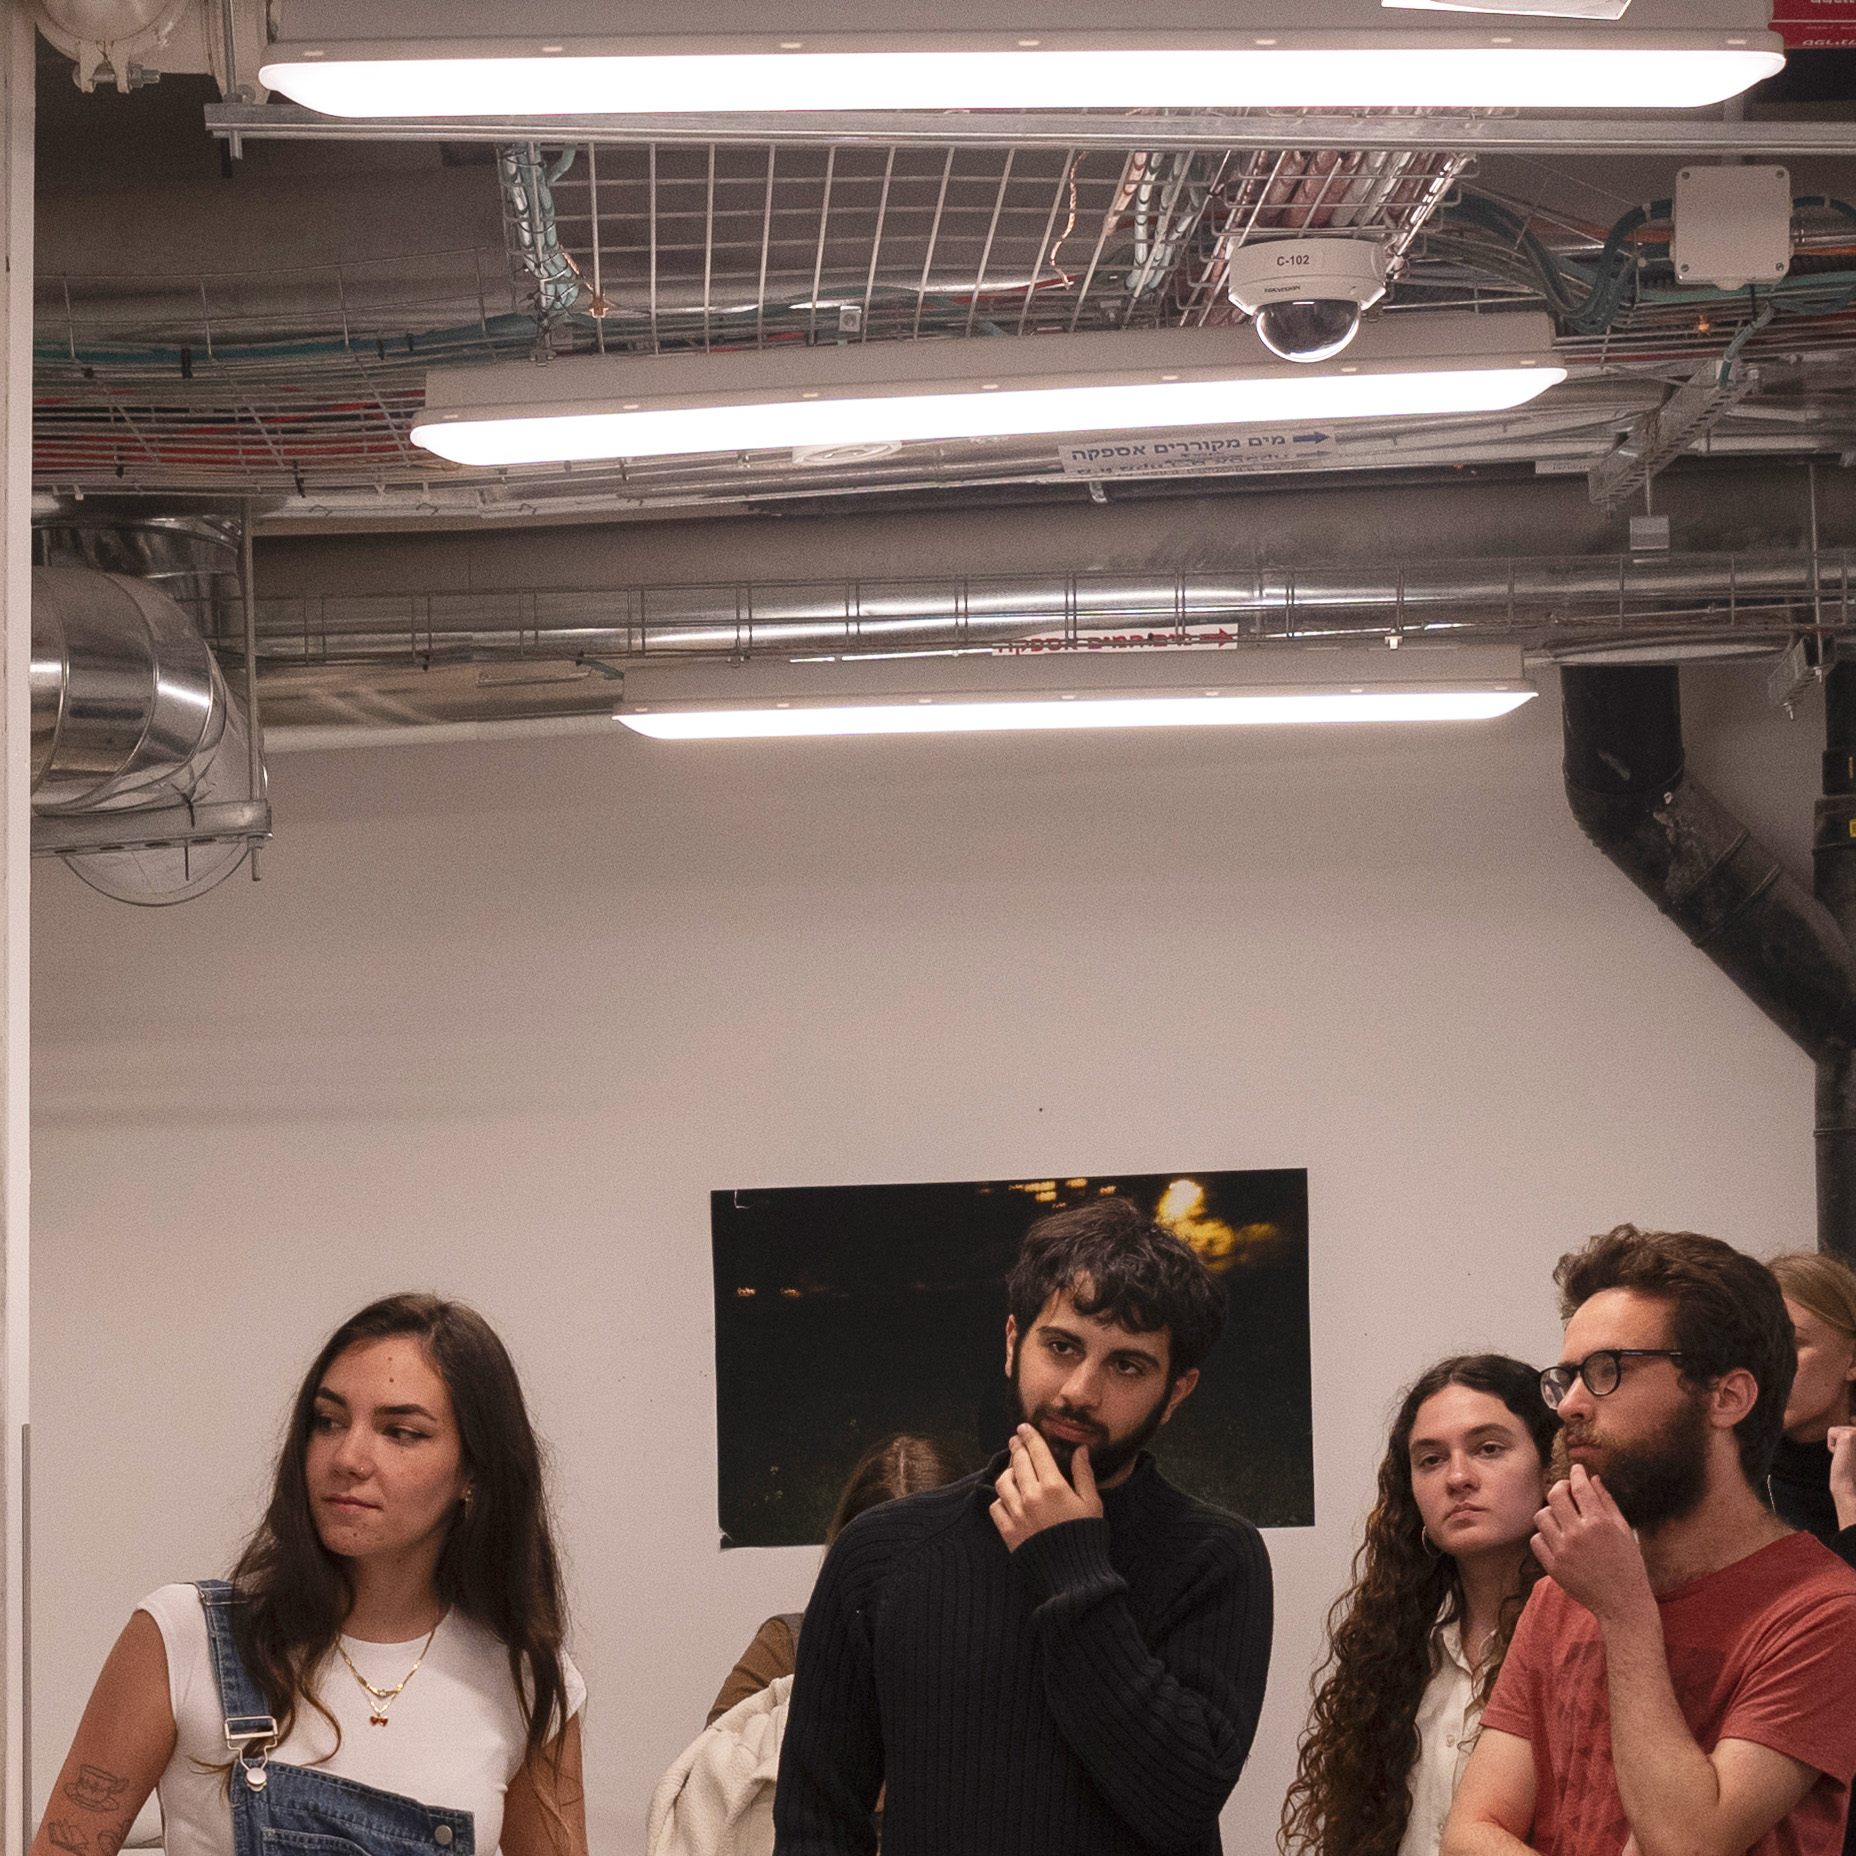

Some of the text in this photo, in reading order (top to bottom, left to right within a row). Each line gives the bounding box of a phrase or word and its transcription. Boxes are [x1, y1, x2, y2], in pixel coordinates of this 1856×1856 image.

[1276, 255, 1310, 266] C-102
[1071, 435, 1286, 461] מים מקוררים אספקה
